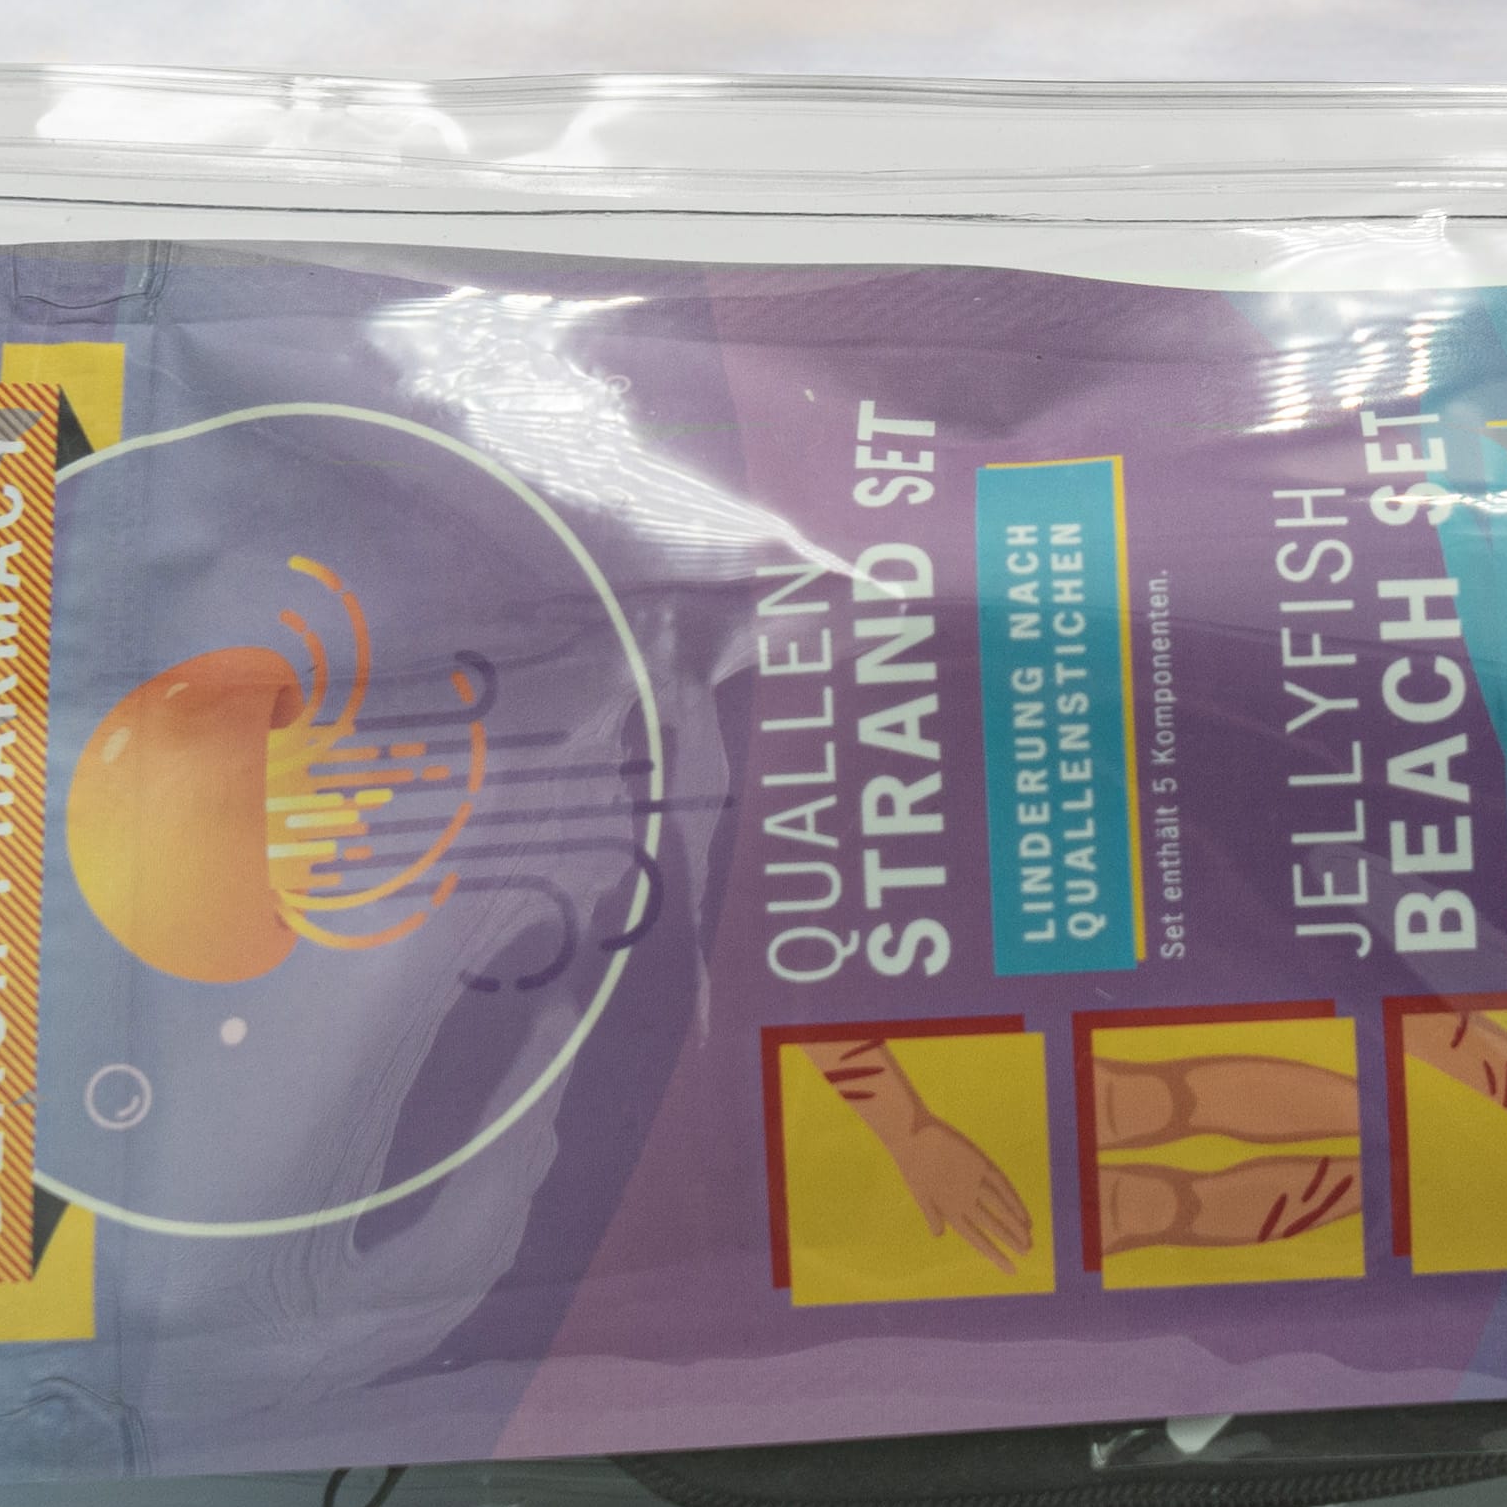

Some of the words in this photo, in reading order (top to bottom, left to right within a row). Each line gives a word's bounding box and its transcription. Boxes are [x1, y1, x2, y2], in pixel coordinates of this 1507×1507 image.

[853, 400, 935, 508] SET
[1361, 410, 1447, 526] SET
[1007, 524, 1042, 641] NACH
[1149, 569, 1178, 766] Komponenten.
[755, 561, 859, 982] QUALLEN
[853, 543, 950, 977] STRAND
[1012, 666, 1055, 942] LINDERUNG
[1050, 523, 1105, 940] QUALLENSTICHEN
[1154, 776, 1177, 794] 5
[1273, 487, 1370, 958] JELLYFISH
[1377, 577, 1476, 953] BEACH
[1154, 806, 1182, 903] enthält
[1159, 903, 1185, 959] Set
